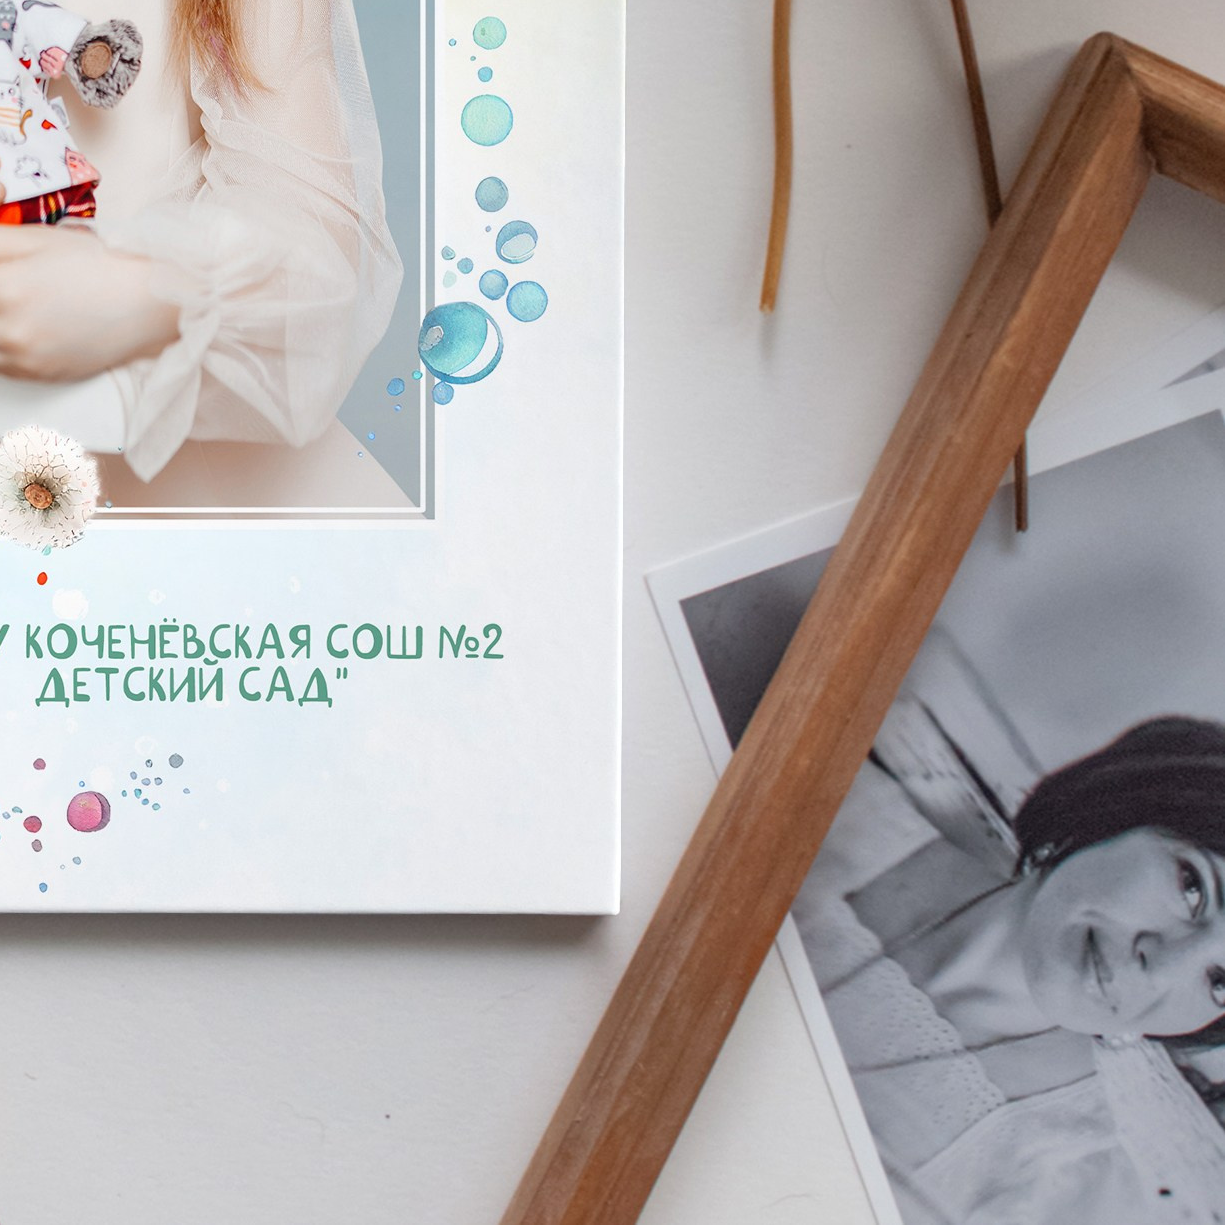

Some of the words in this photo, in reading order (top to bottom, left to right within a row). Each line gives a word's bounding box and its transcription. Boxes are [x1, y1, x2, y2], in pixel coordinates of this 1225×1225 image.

[26, 617, 311, 659] КОЧЕНЁВСКАЯ
[326, 623, 423, 659] СОШ
[439, 623, 504, 659] №2
[35, 657, 223, 707] ДЕТСКИЙ
[239, 665, 348, 708] САД"
